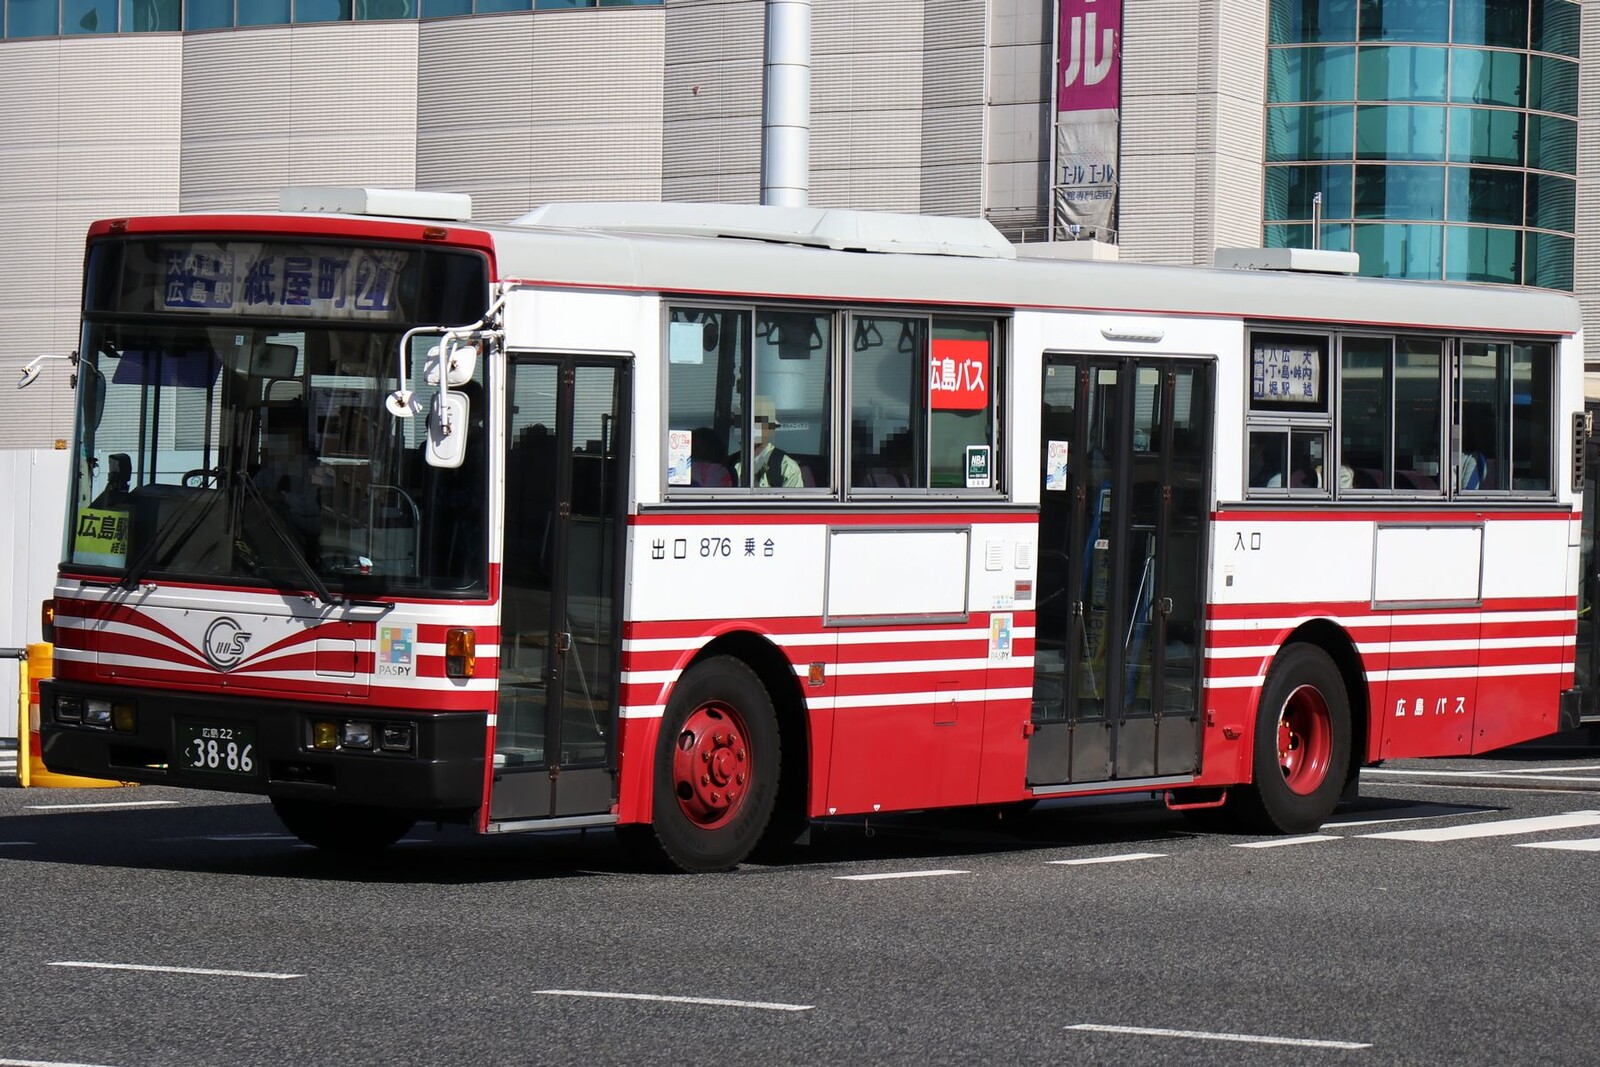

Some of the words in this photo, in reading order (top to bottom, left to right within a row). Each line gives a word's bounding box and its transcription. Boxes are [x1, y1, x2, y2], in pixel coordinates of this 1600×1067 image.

[1065, 0, 1113, 87] ル
[166, 281, 233, 304] 広島駅
[244, 257, 349, 308] 紙屋町
[931, 357, 985, 392] 広島バス
[652, 538, 687, 560] 出口
[699, 537, 731, 557] 876
[744, 537, 775, 557] 乗合
[1234, 532, 1261, 550] 入口
[991, 651, 1010, 660] PASPY
[379, 665, 411, 676] PASPY
[202, 728, 218, 738] 広島
[220, 728, 233, 739] 22
[193, 739, 253, 772] 38-86
